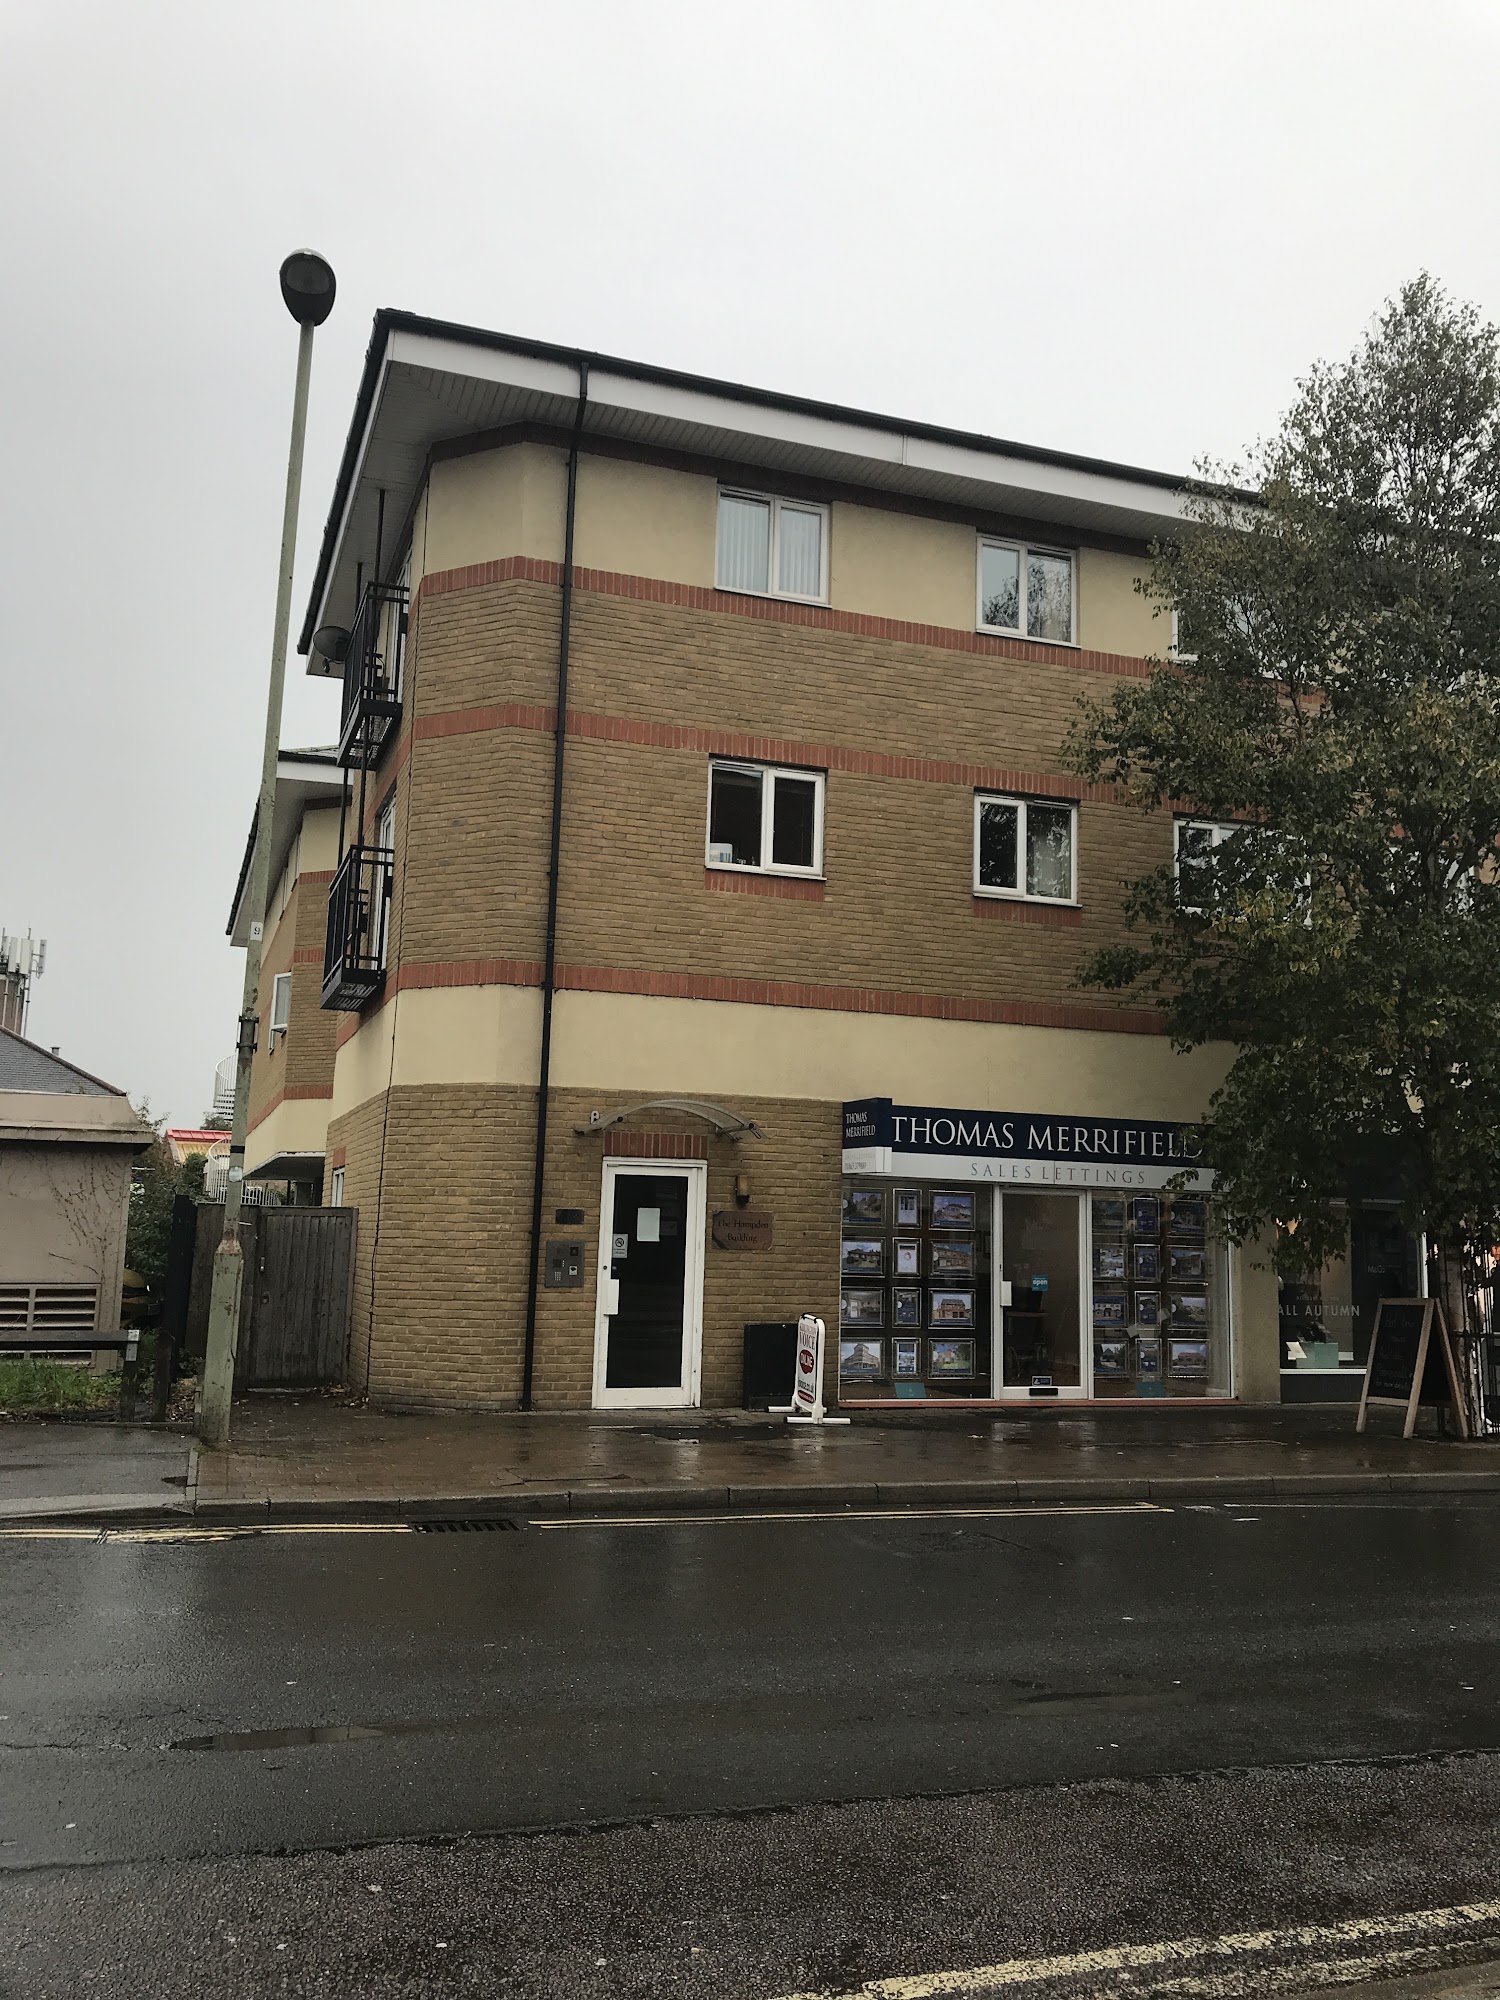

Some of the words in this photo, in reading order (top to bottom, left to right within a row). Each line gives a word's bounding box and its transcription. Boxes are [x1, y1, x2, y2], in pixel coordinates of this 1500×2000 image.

[254, 926, 261, 935] 9
[846, 1112, 868, 1124] THOMAS
[846, 1125, 876, 1138] MERRIFIELD
[892, 1116, 1014, 1149] THOMAS
[1027, 1124, 1203, 1159] MERRIFIELD
[971, 1162, 1032, 1179] SALES
[1042, 1166, 1145, 1185] LETTINGS
[718, 1219, 731, 1228] The
[734, 1219, 769, 1230] Hampden
[727, 1232, 758, 1244] Building
[1278, 1304, 1299, 1316] ALL
[1305, 1305, 1360, 1317] AUTUMN
[800, 1331, 816, 1350] VOICE
